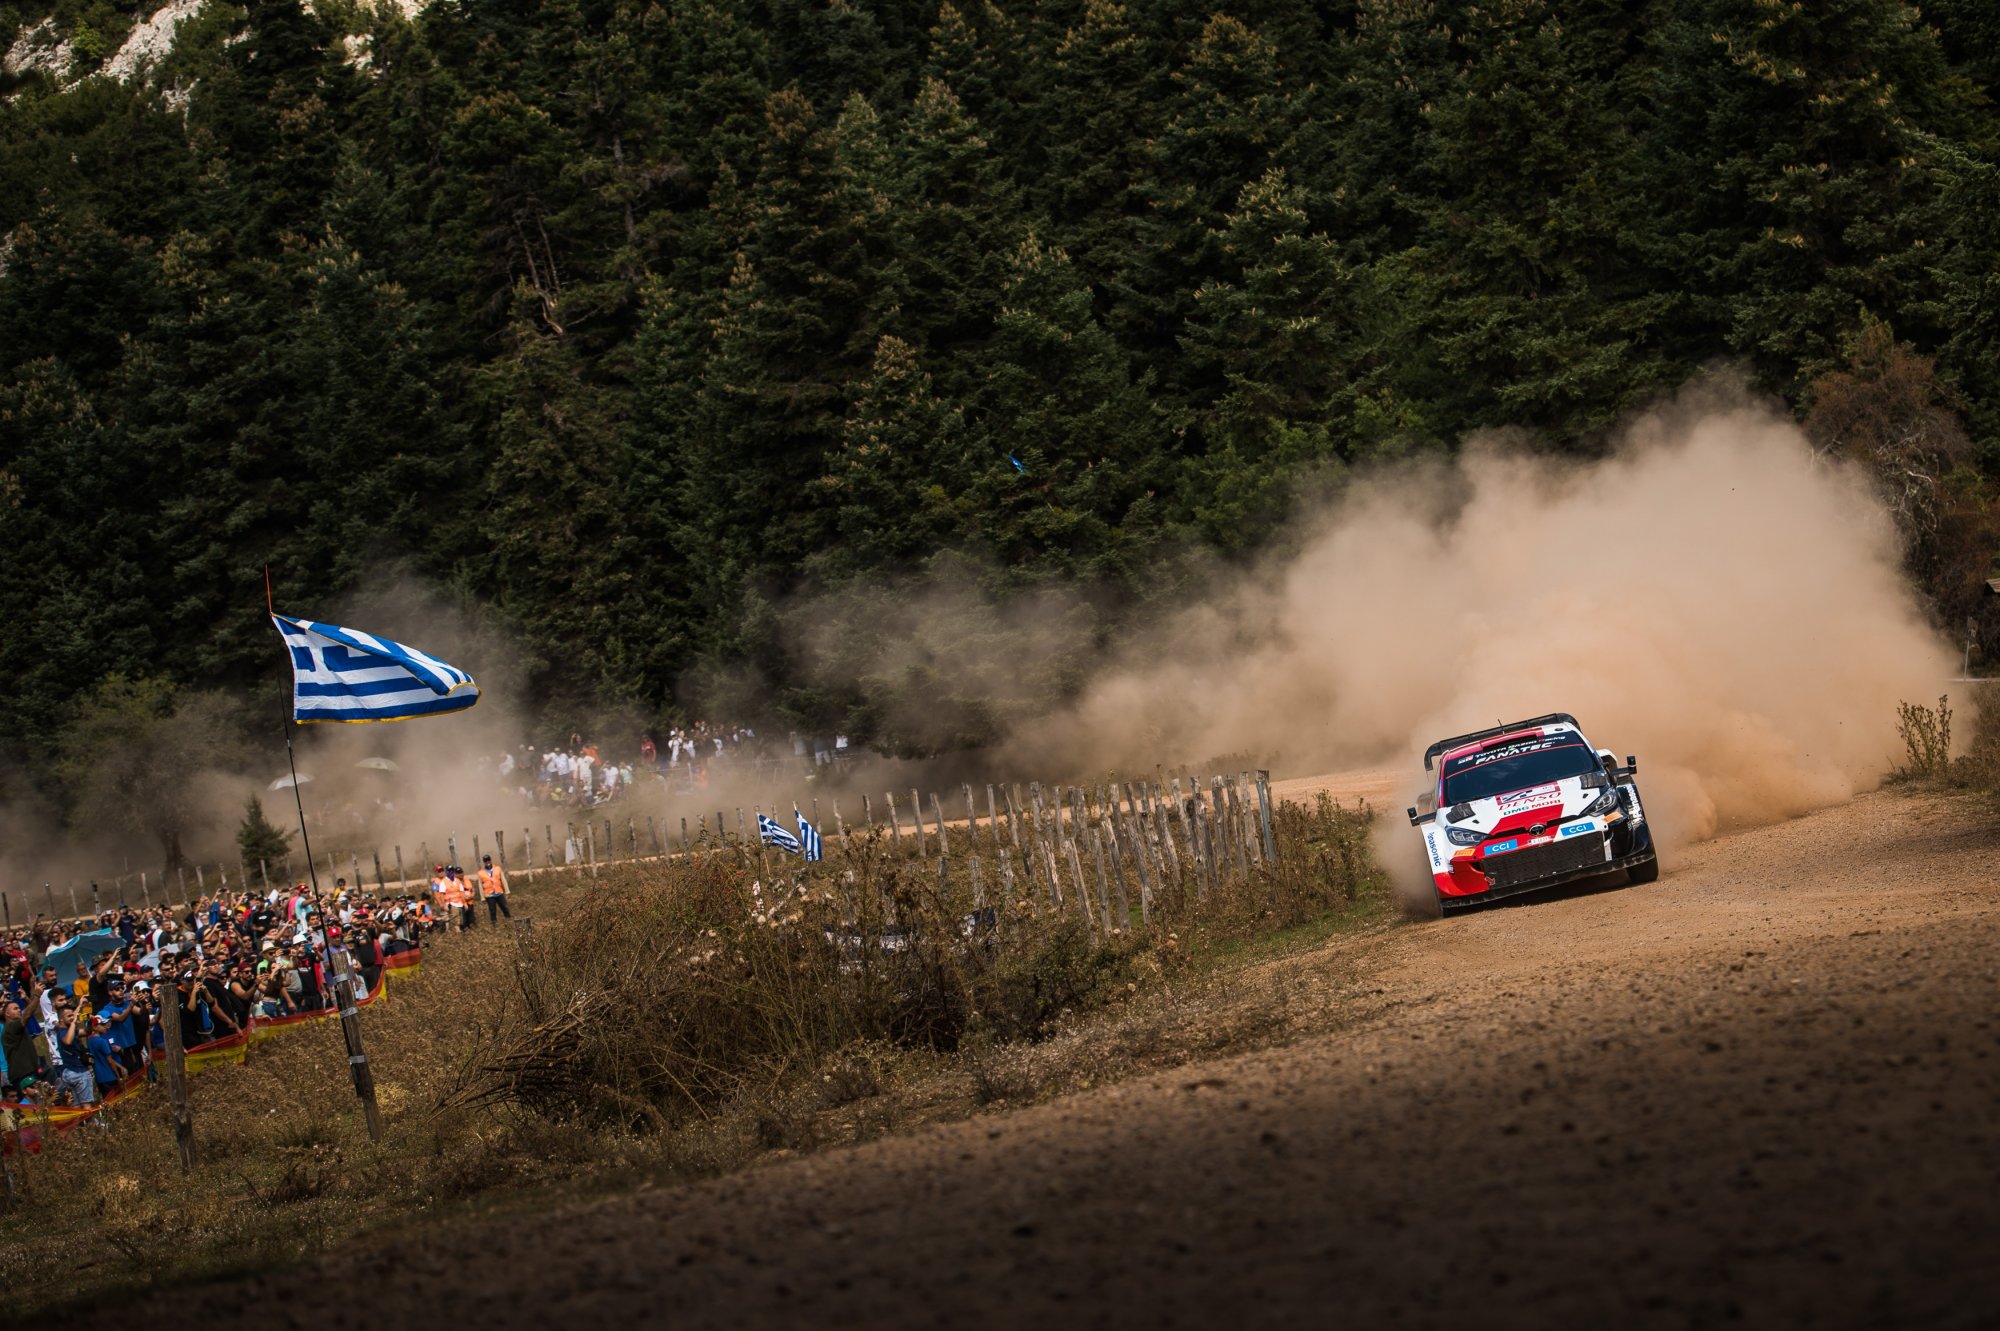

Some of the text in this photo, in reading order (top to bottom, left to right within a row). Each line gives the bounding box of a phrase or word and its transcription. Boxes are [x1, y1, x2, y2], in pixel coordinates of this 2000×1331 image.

[1475, 747, 1506, 758] TOYOTA
[1475, 742, 1553, 765] FANATEC
[1499, 792, 1561, 811] DENSO
[1504, 799, 1561, 816] DMG MORI
[1568, 825, 1587, 834] CCI
[1492, 842, 1510, 852] CCI
